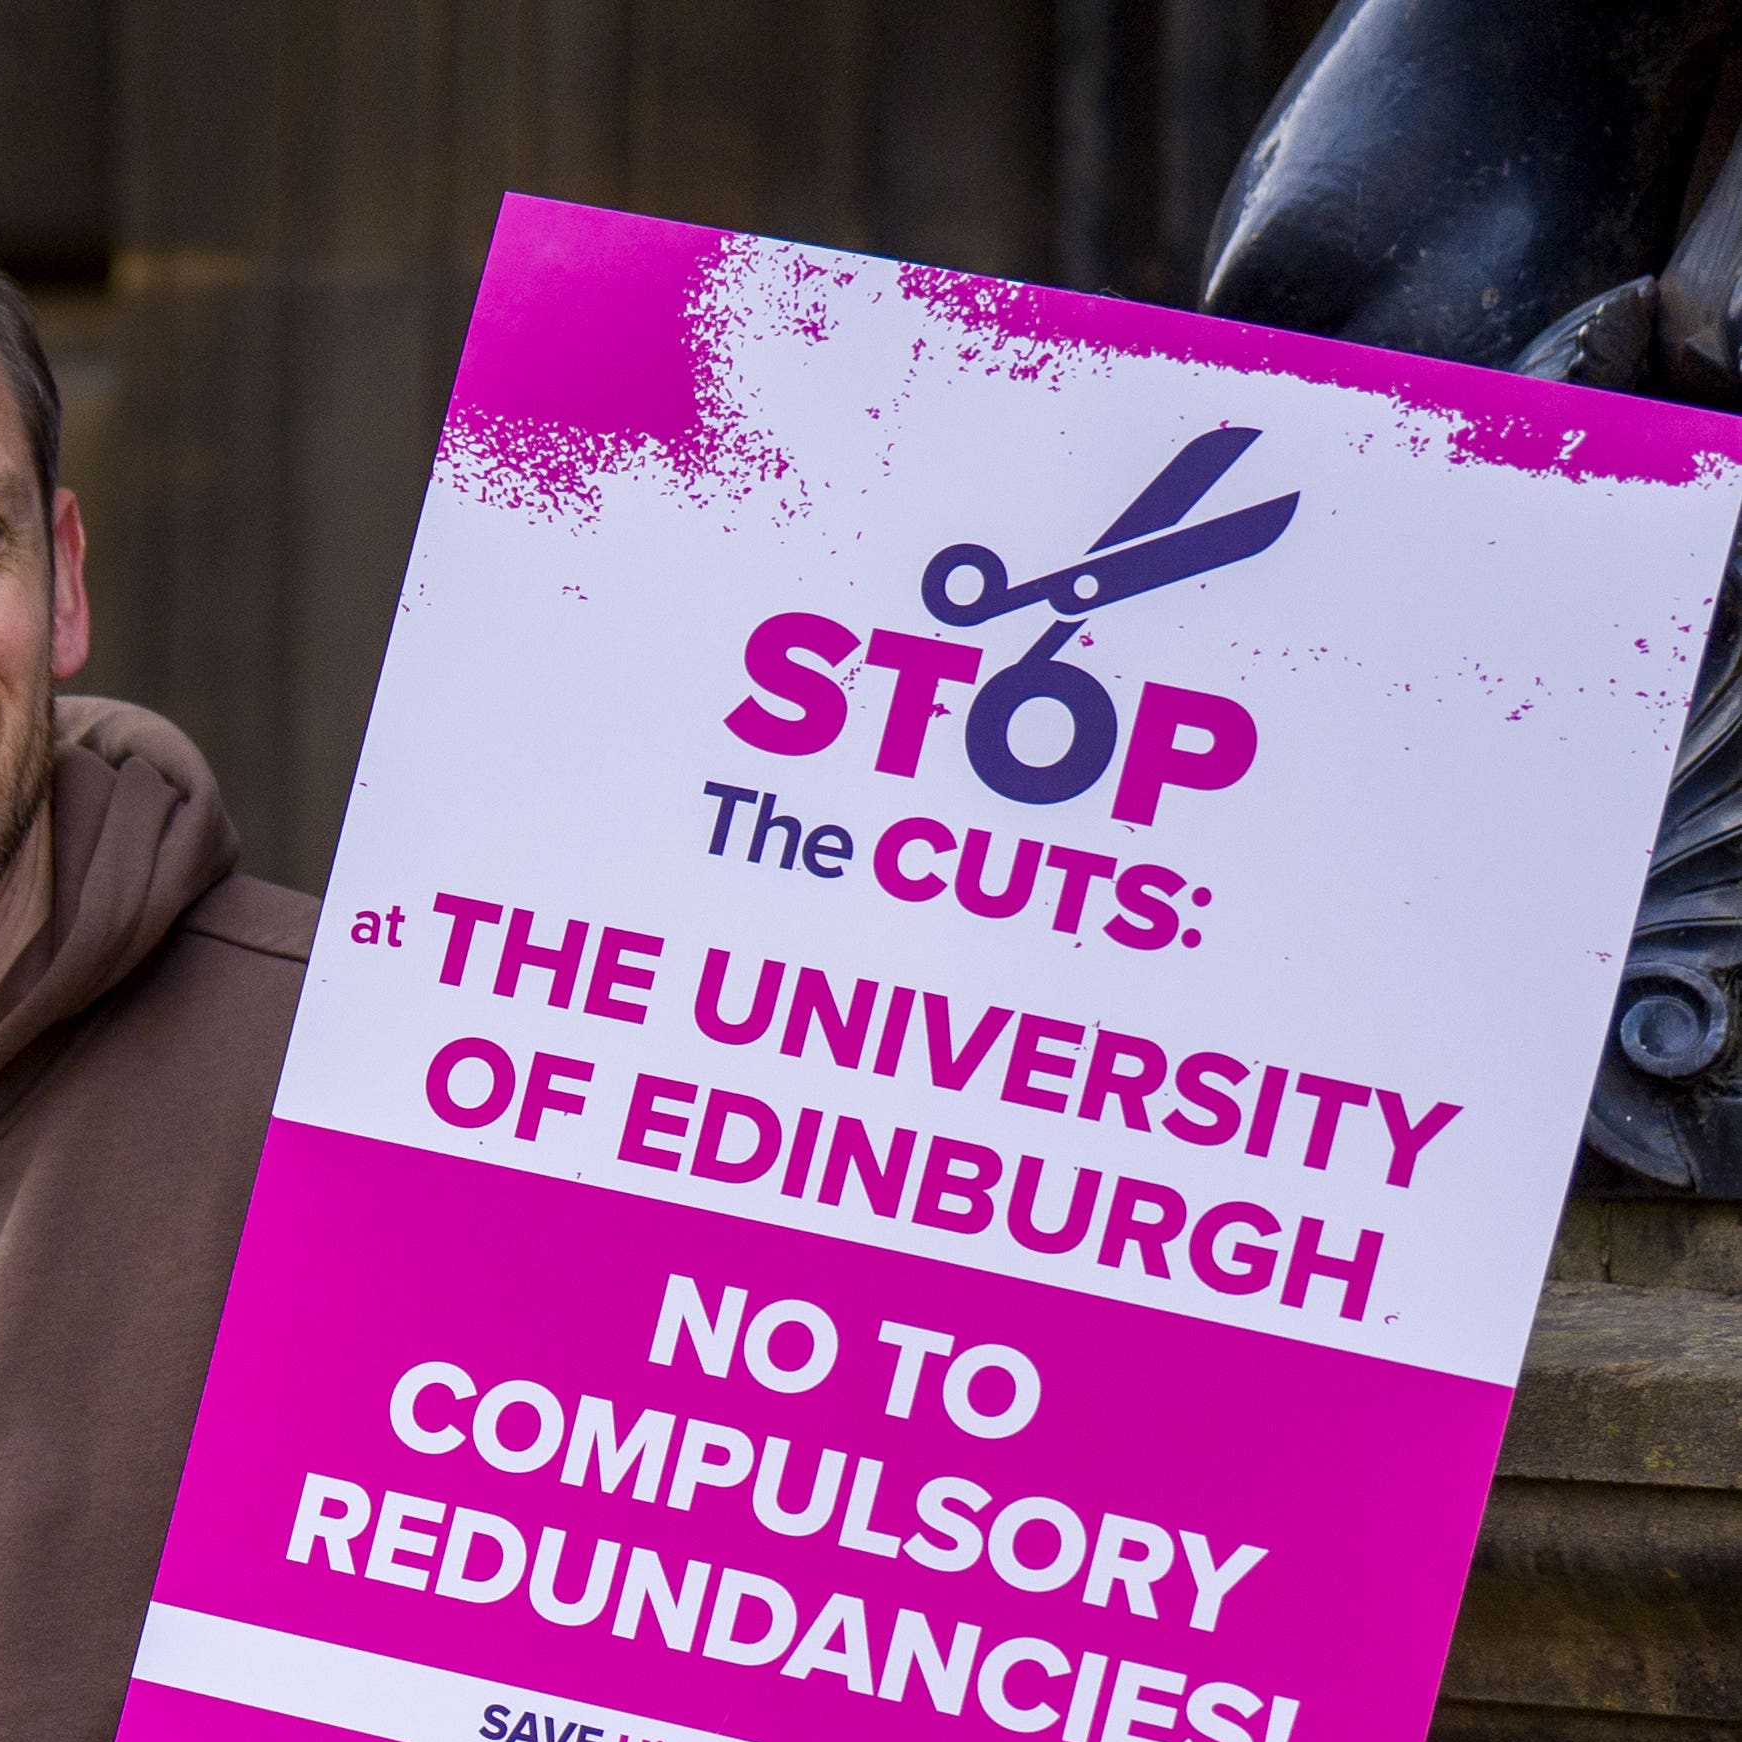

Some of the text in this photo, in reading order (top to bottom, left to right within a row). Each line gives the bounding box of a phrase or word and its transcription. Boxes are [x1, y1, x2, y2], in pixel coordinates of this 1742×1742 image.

[724, 612, 1257, 826] STOP
[704, 781, 1212, 950] The CUTS:
[351, 892, 1462, 1188] at THE UNIVERSITY
[426, 1037, 1384, 1322] OF EDINBURGH
[649, 1274, 1041, 1439] NO TO
[390, 1362, 1268, 1632] COMPULSORY
